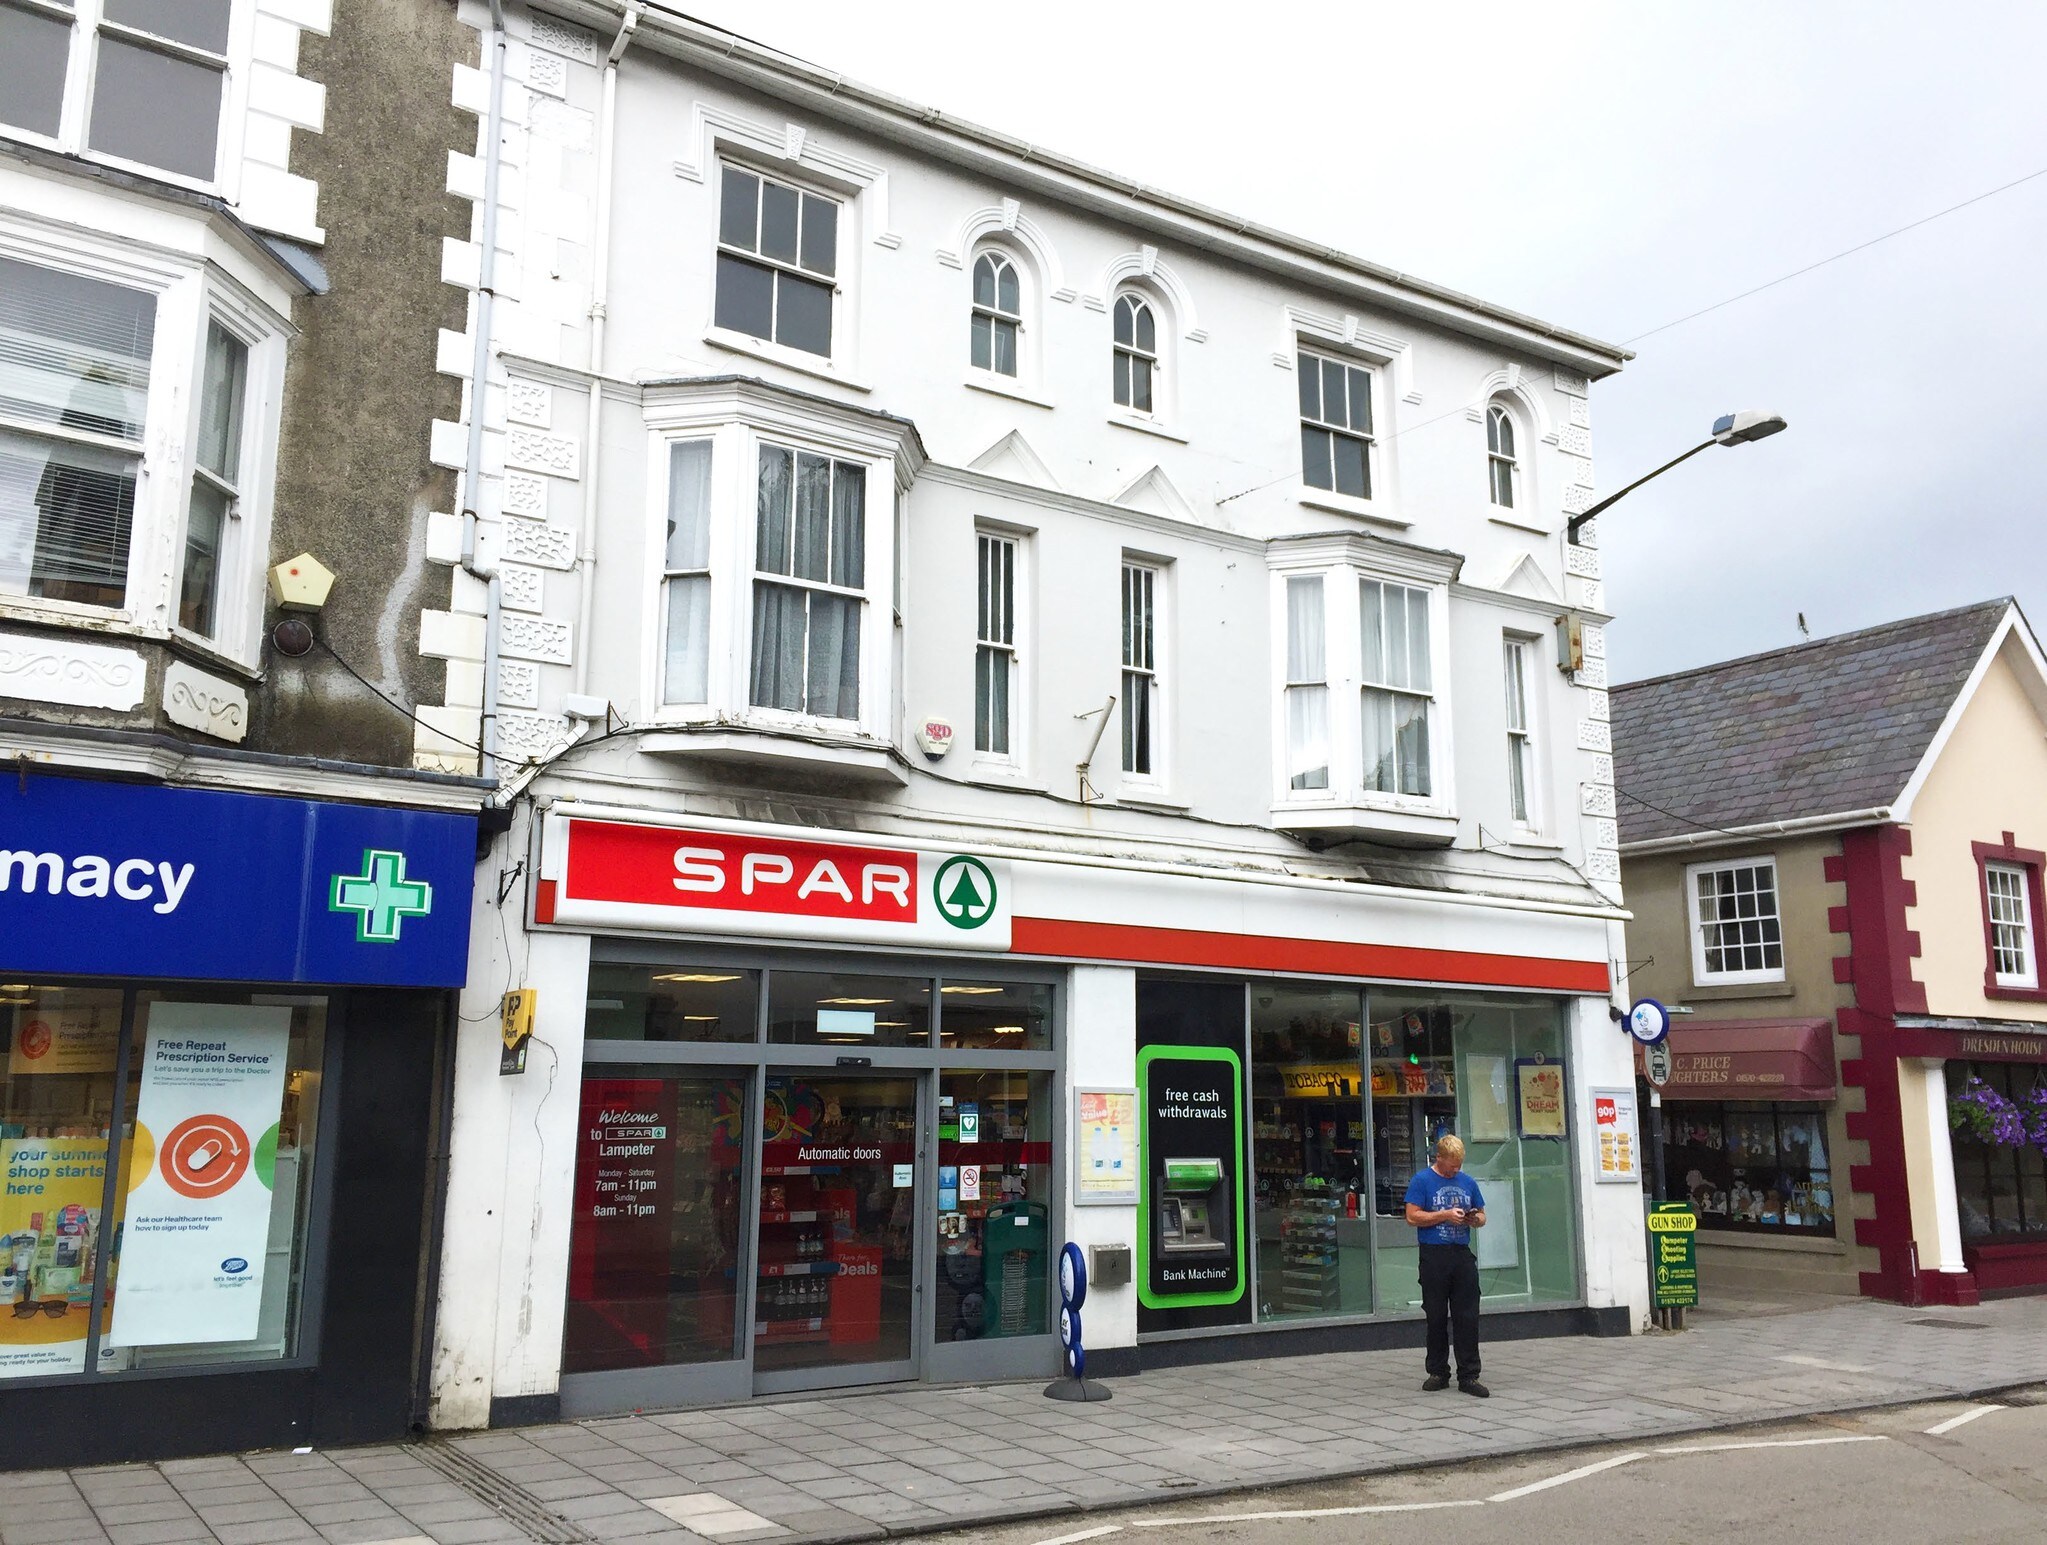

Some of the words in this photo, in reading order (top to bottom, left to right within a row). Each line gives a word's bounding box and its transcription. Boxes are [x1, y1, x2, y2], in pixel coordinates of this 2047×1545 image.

[0, 849, 195, 914] macy
[673, 846, 909, 907] SPAR
[157, 1040, 183, 1049] Free
[185, 1040, 226, 1052] Repeat
[1962, 1037, 2008, 1053] DRESDEN
[156, 1051, 225, 1063] Prescription
[1692, 1056, 1731, 1070] PRICE
[211, 1066, 224, 1075] trip
[247, 1067, 271, 1075] Doctor
[1286, 1071, 1343, 1088] TOBACCO
[1165, 1088, 1189, 1101] free
[1192, 1089, 1219, 1102] cash
[1527, 1100, 1559, 1109] DREAM
[598, 1109, 659, 1124] Welcome
[1158, 1105, 1227, 1118] withdrawals
[1597, 1106, 1614, 1117] 90p
[590, 1128, 602, 1140] to
[617, 1129, 652, 1137] SPAR
[9, 1150, 48, 1163] your
[599, 1143, 656, 1158] Lampeter
[797, 1147, 850, 1160] Automatic
[853, 1146, 881, 1160] doors
[8, 1165, 49, 1179] shop
[55, 1165, 104, 1177] starts
[598, 1169, 622, 1178] Monday
[628, 1168, 655, 1177] Saturday
[6, 1182, 44, 1195] here
[595, 1180, 618, 1192] 7am
[628, 1179, 656, 1192] 11pm
[614, 1194, 637, 1203] Sunday
[593, 1205, 617, 1217] 8am
[627, 1204, 656, 1217] 11pm
[161, 1224, 177, 1232] sign
[188, 1224, 209, 1232] today
[1651, 1216, 1669, 1229] GUN
[1671, 1216, 1693, 1229] SHOP
[838, 1261, 878, 1276] Deals
[1163, 1269, 1186, 1281] Bank
